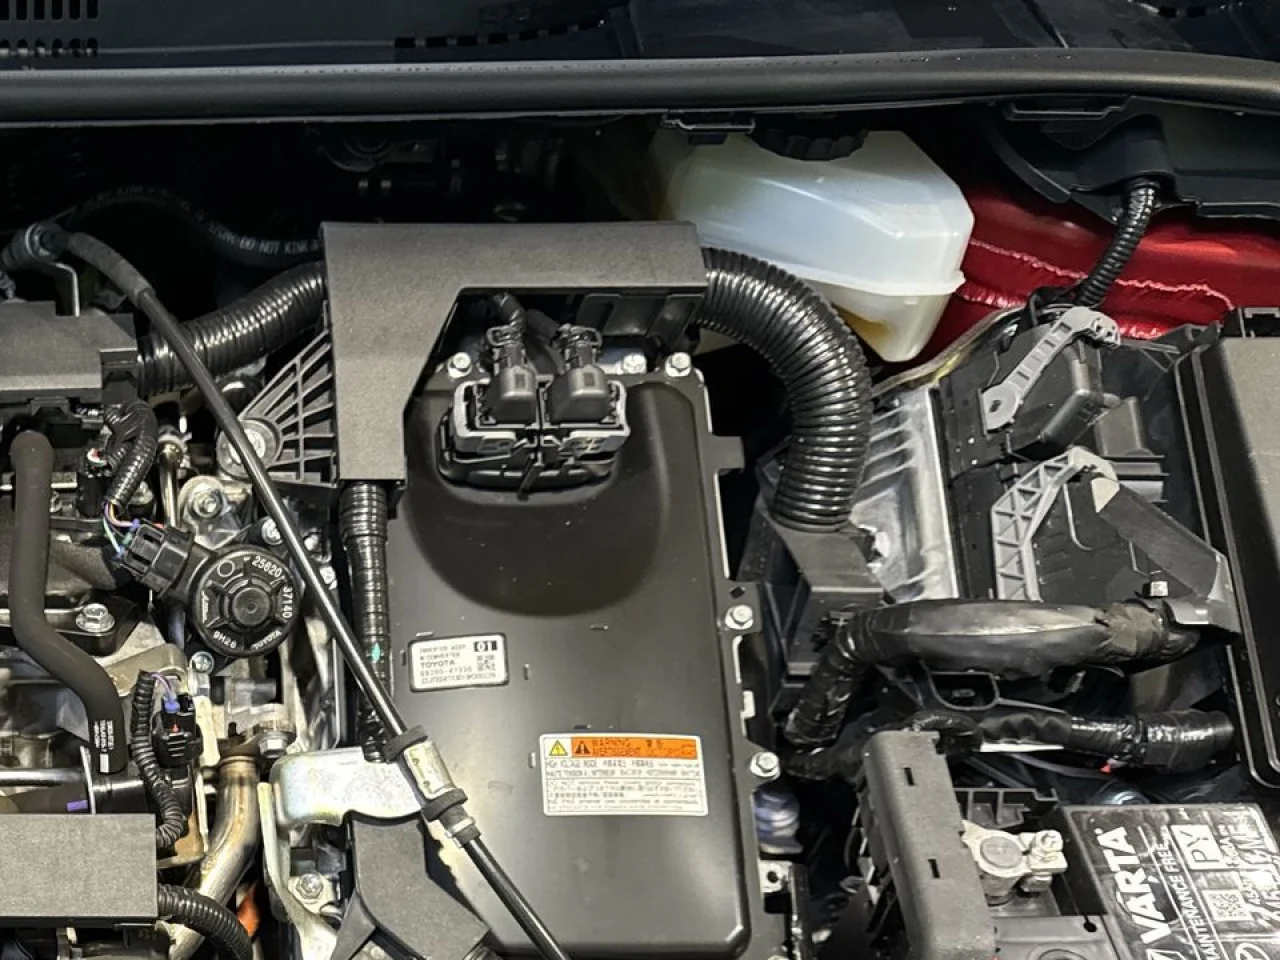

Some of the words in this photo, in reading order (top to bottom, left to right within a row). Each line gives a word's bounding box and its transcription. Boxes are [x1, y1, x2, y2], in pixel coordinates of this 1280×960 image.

[251, 555, 283, 578] 25620
[282, 586, 293, 618] 37140
[476, 640, 493, 652] 01
[420, 659, 456, 668] TOYOTA
[1155, 842, 1181, 873] FREE
[1179, 829, 1220, 863] PY
[1096, 826, 1171, 945] VARTA
